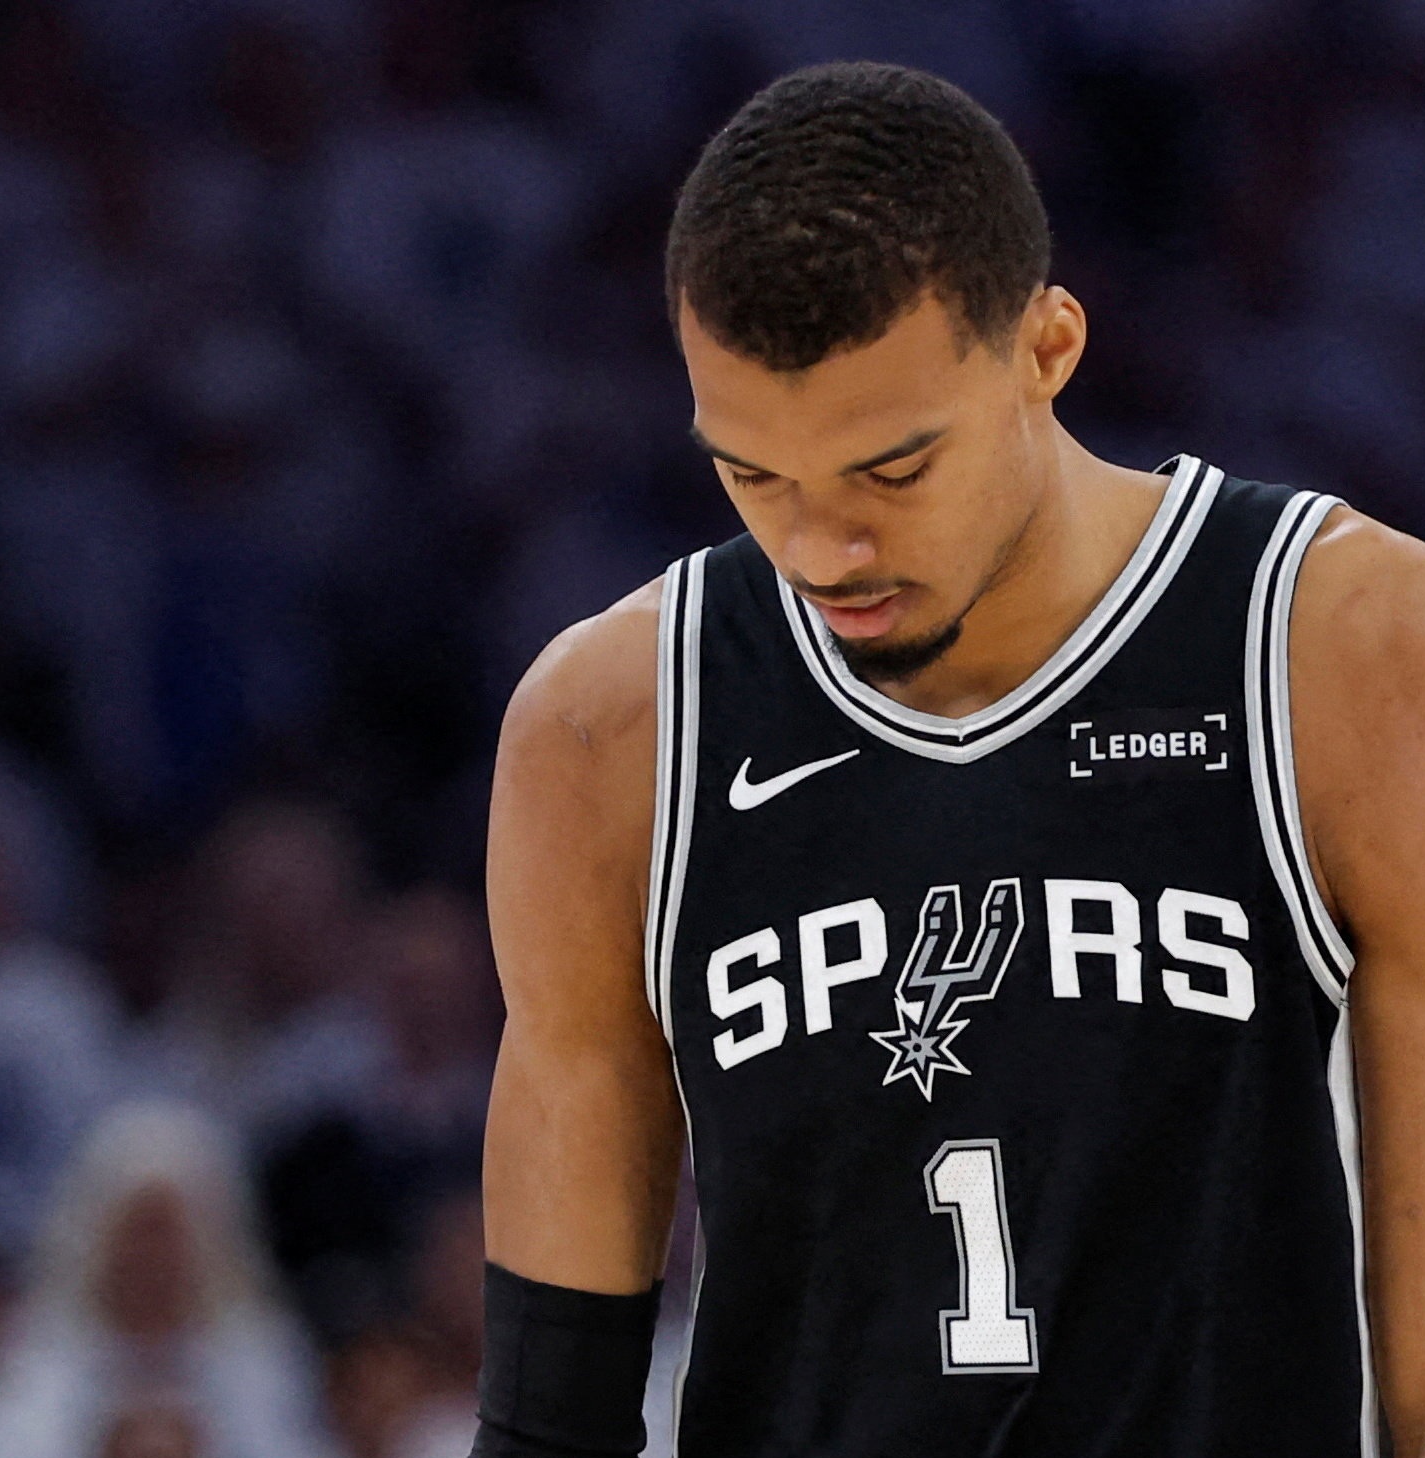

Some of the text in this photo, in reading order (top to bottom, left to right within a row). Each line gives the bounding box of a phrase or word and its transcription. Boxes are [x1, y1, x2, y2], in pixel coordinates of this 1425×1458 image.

[1090, 731, 1207, 761] LEDGER
[706, 877, 1256, 1102] SPURS
[923, 1138, 1040, 1376] 1
